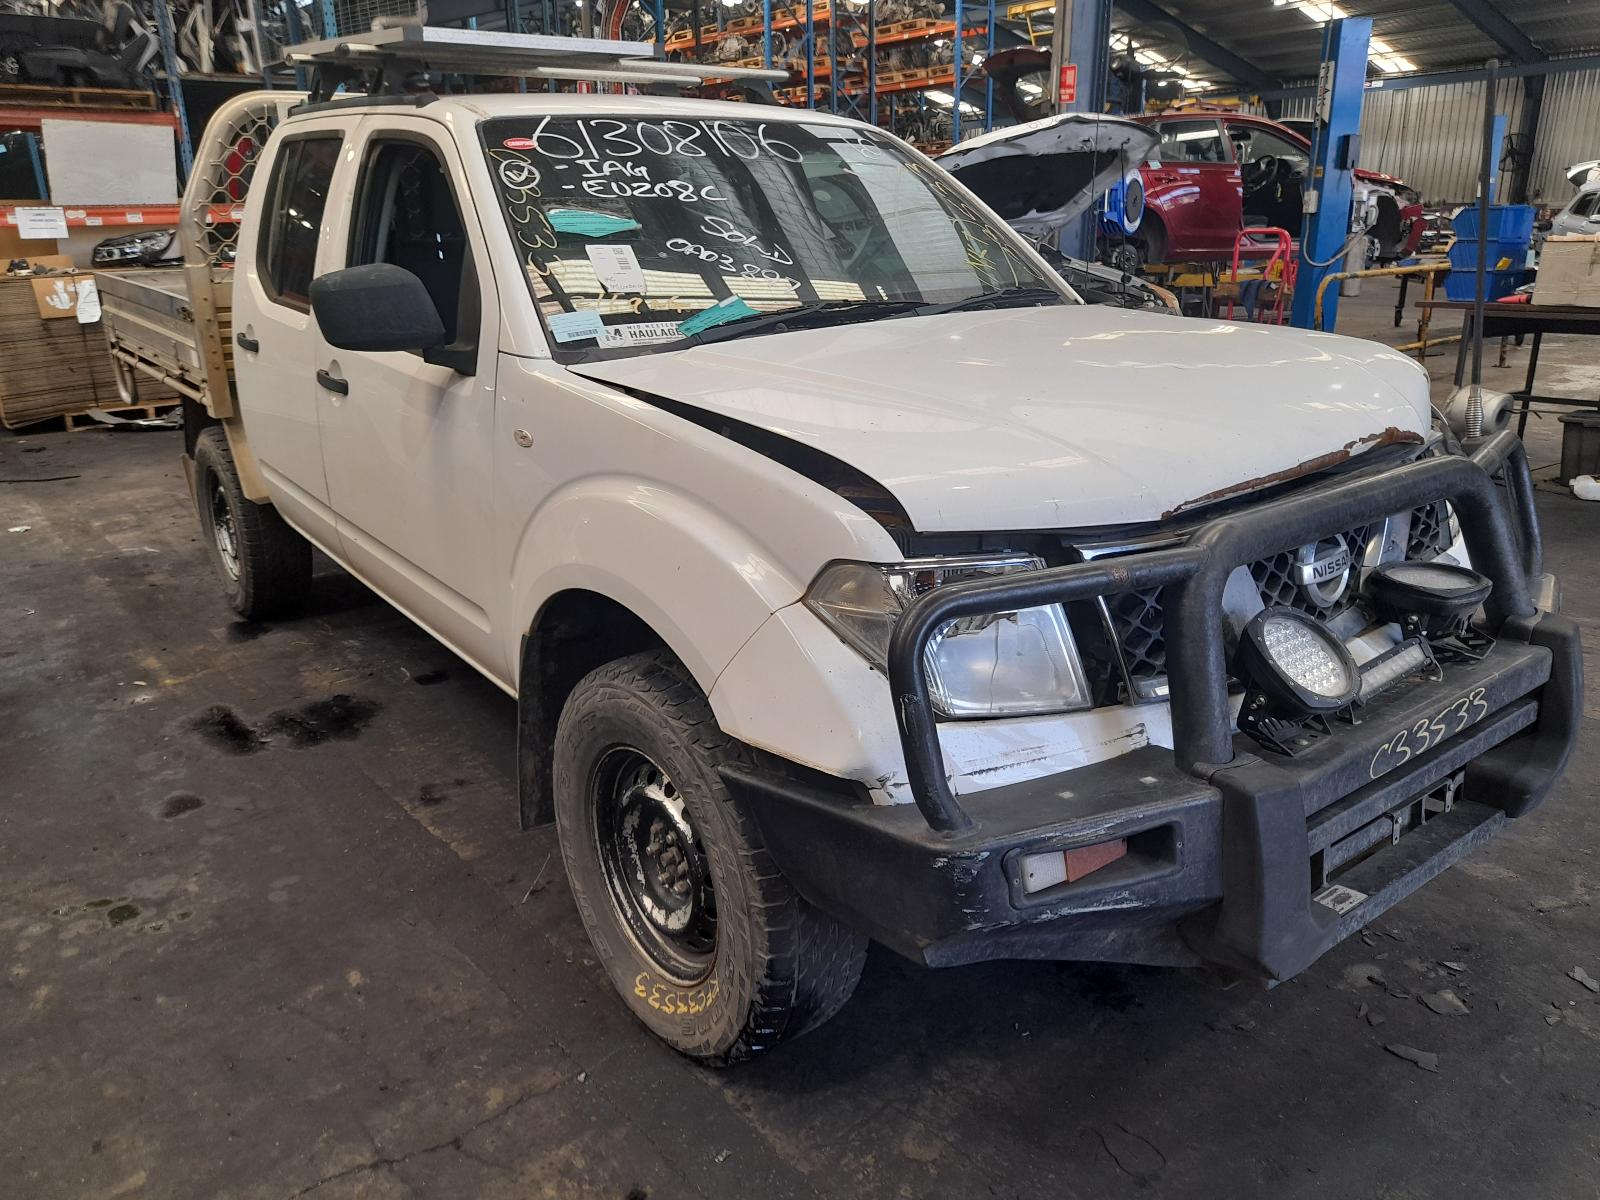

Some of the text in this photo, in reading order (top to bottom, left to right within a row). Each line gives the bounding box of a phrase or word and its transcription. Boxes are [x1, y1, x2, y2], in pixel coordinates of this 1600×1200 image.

[533, 115, 803, 162] 61308106
[575, 159, 650, 181] IAG
[628, 327, 683, 339] HAULAGE
[1369, 687, 1488, 779] C33533
